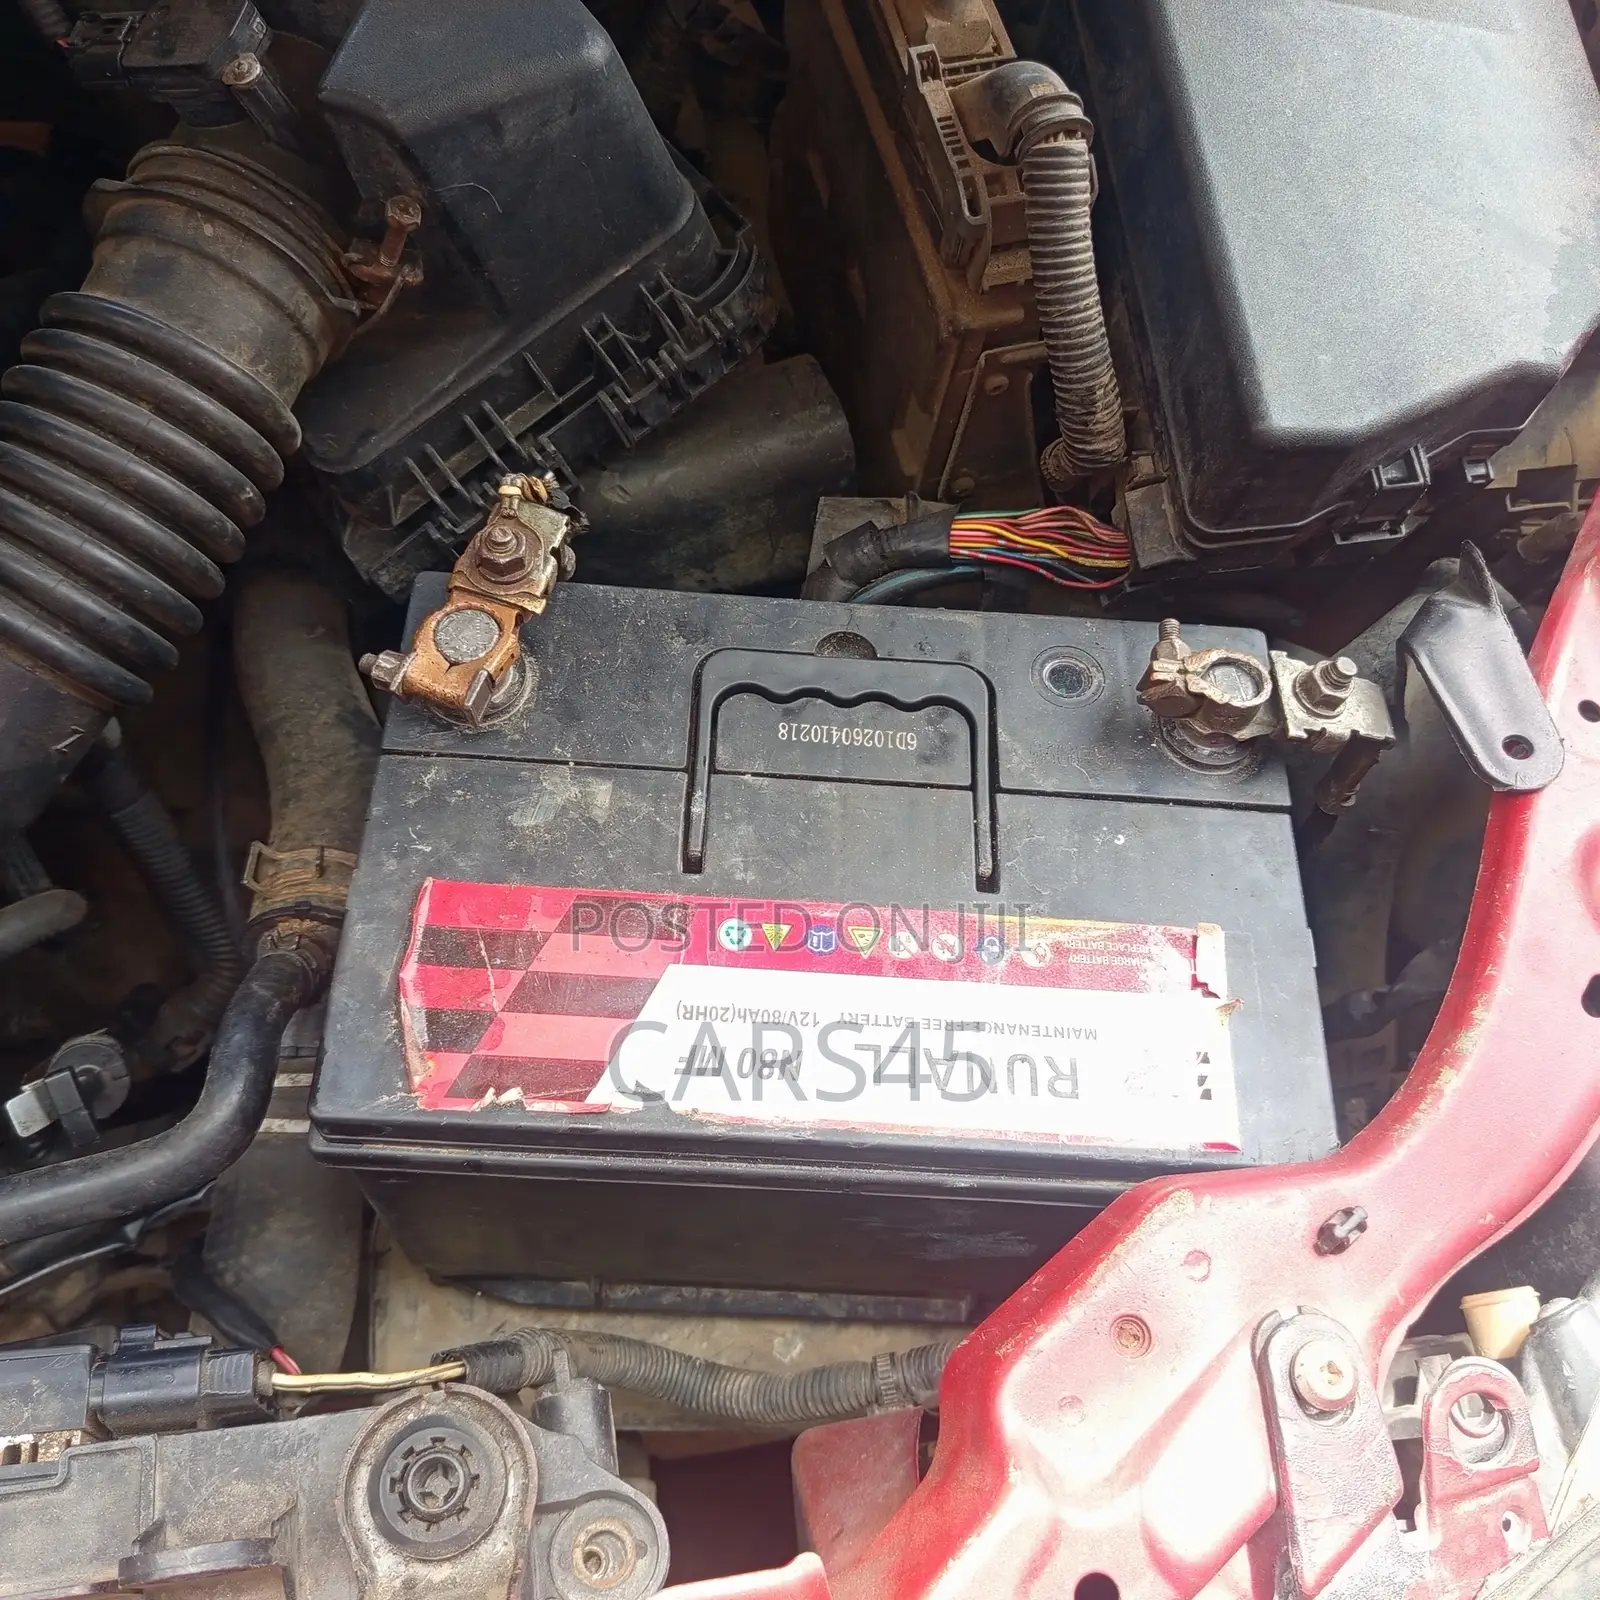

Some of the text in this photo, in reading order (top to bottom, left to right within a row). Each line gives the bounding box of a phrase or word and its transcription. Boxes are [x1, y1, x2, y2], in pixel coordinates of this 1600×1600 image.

[778, 722, 917, 750] 6D10260410218
[1065, 938, 1106, 950] BATTERY
[1069, 953, 1110, 965] BATTERY
[676, 1000, 820, 1028] 12V/80Ah(20HR)
[839, 1011, 914, 1029] BATTERY
[674, 1044, 727, 1077] MF
